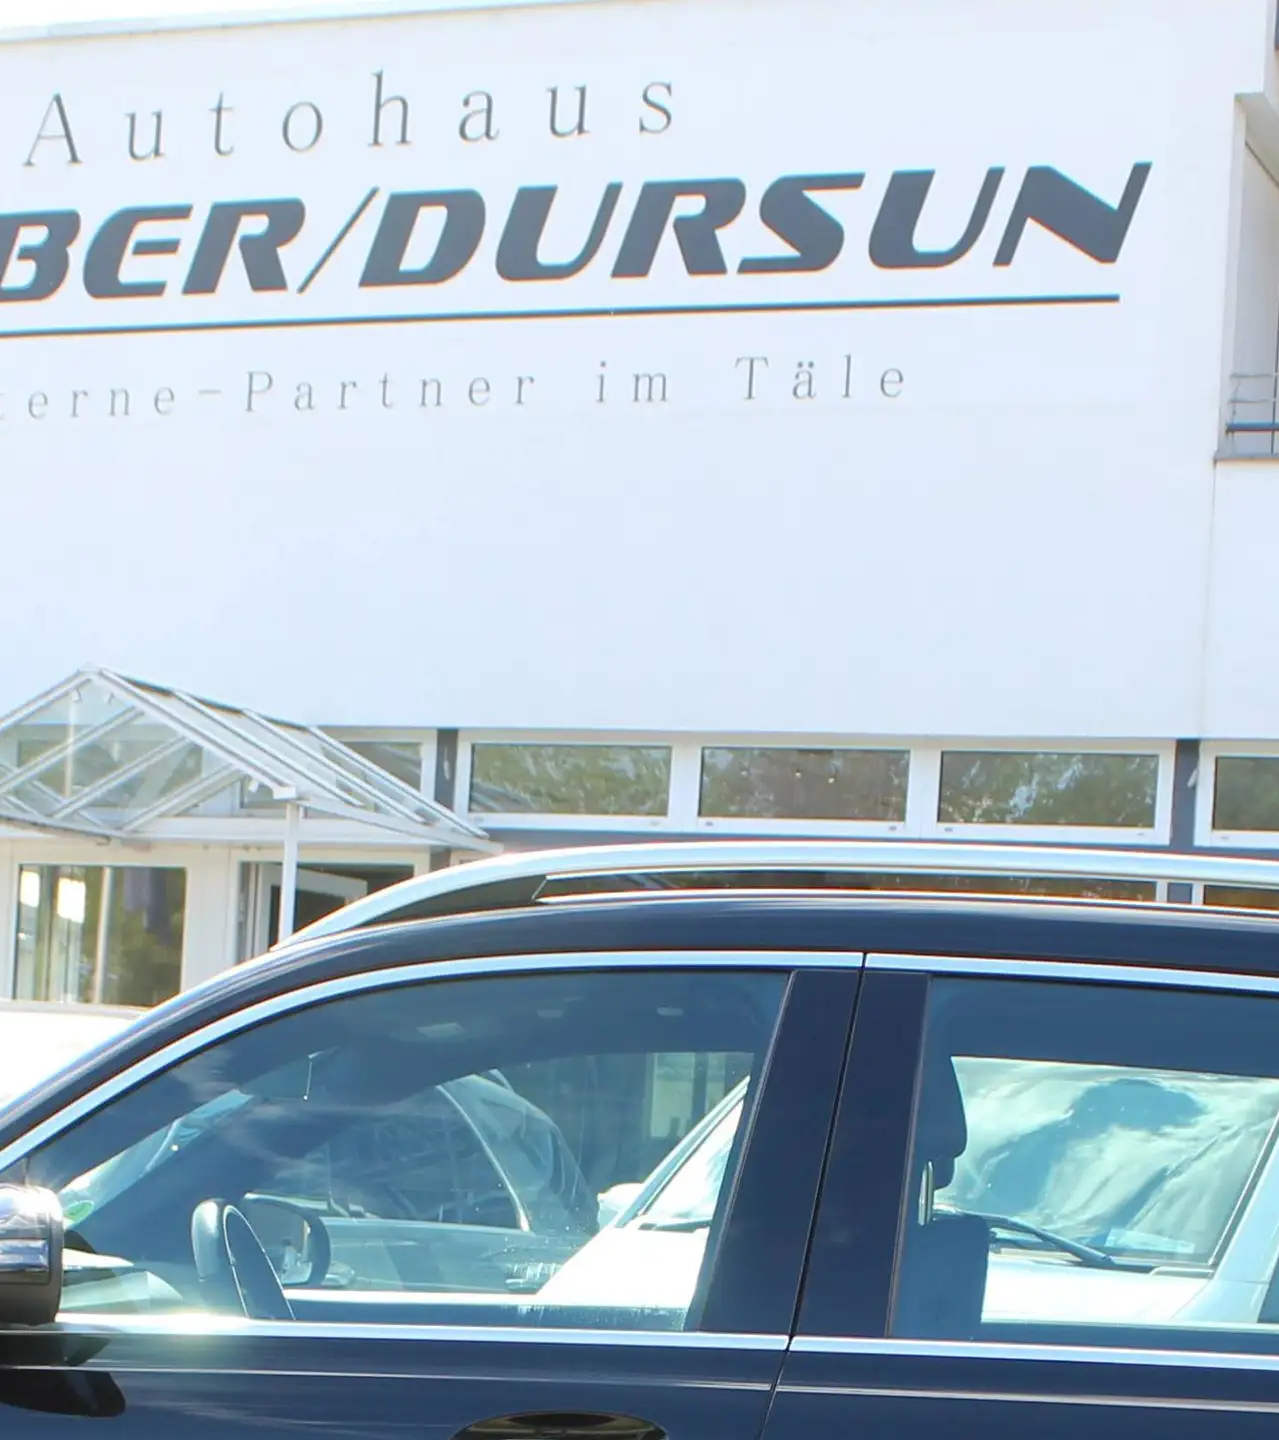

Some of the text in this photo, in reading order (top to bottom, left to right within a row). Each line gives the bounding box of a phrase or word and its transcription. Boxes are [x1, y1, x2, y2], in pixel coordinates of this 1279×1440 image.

[23, 69, 673, 166] Autohaus
[595, 361, 669, 404] im
[735, 354, 905, 402] Täle
